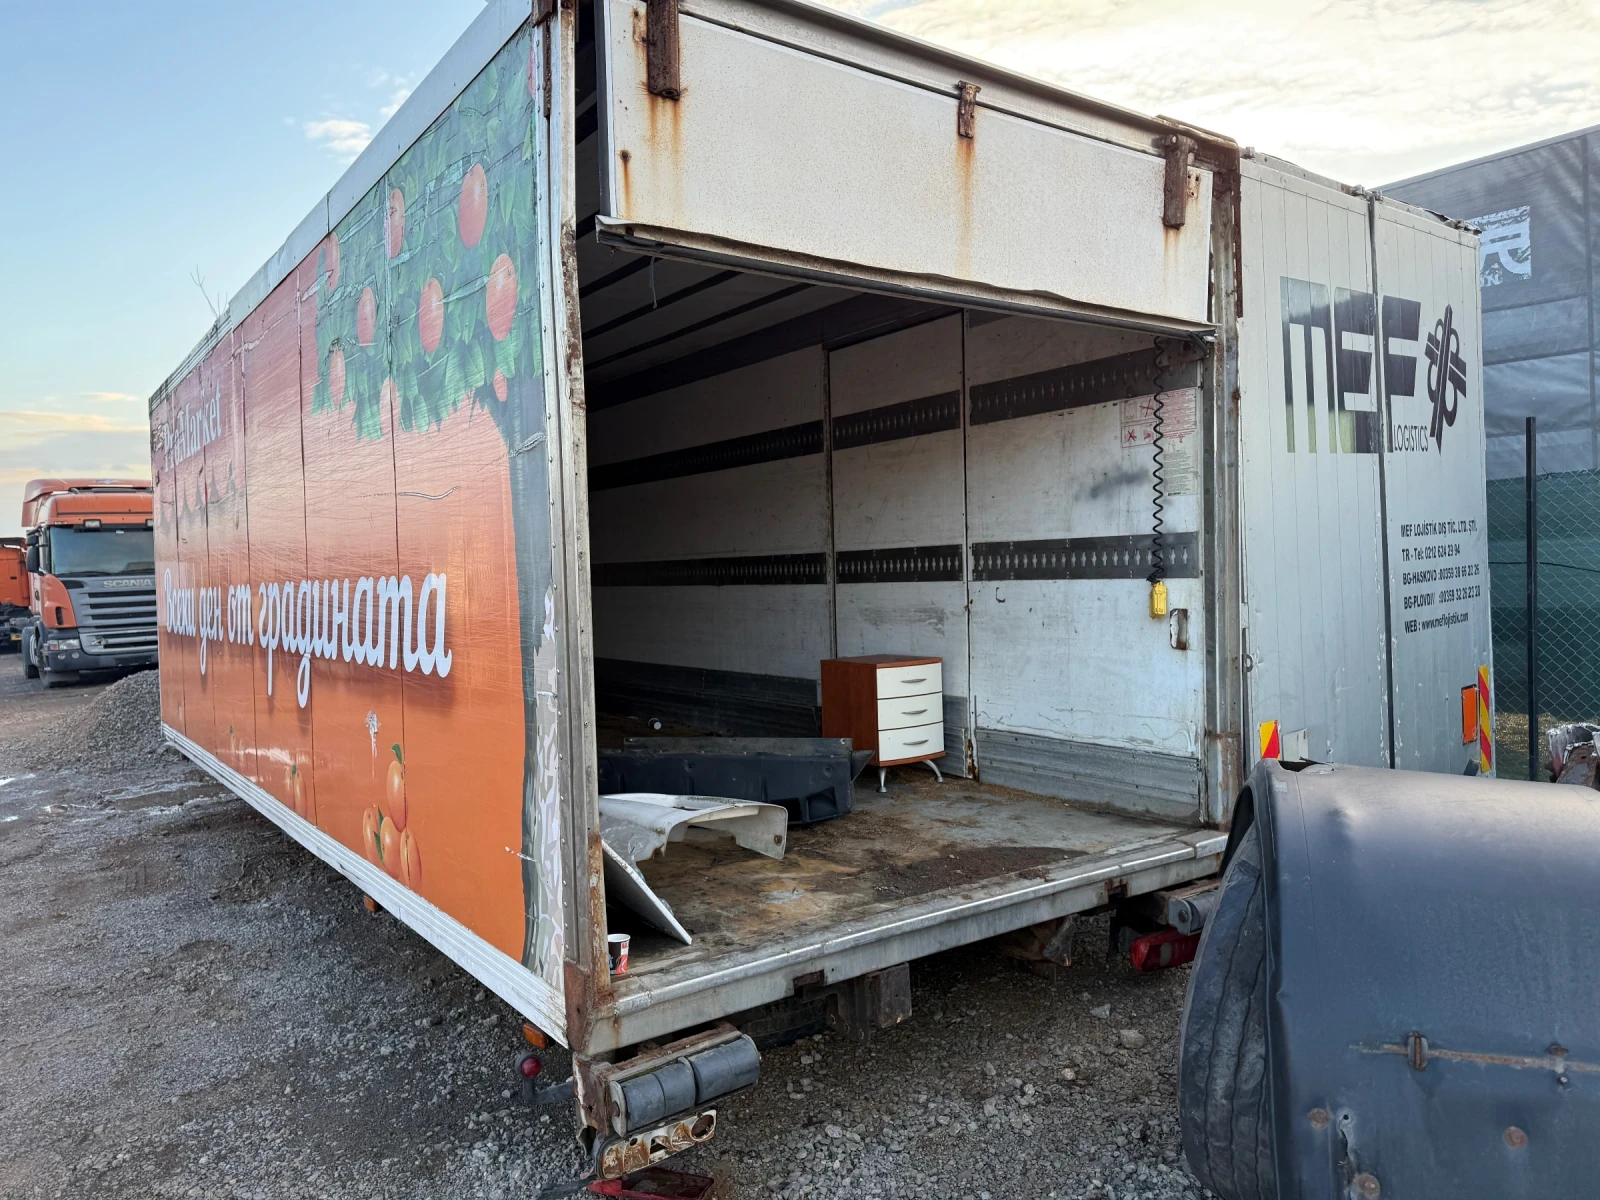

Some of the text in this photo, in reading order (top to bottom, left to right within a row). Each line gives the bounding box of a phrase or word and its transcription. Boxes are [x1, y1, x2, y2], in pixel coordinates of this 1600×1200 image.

[1280, 276, 1421, 454] MEF
[1393, 424, 1429, 452] LOGISTICS
[1401, 523, 1412, 537] MEF
[1401, 548, 1410, 562] TR
[1425, 545, 1437, 560] 0212
[103, 579, 152, 588] SCANIA
[1405, 619, 1418, 634] WEB
[164, 567, 453, 708] Всеки ден от градината
